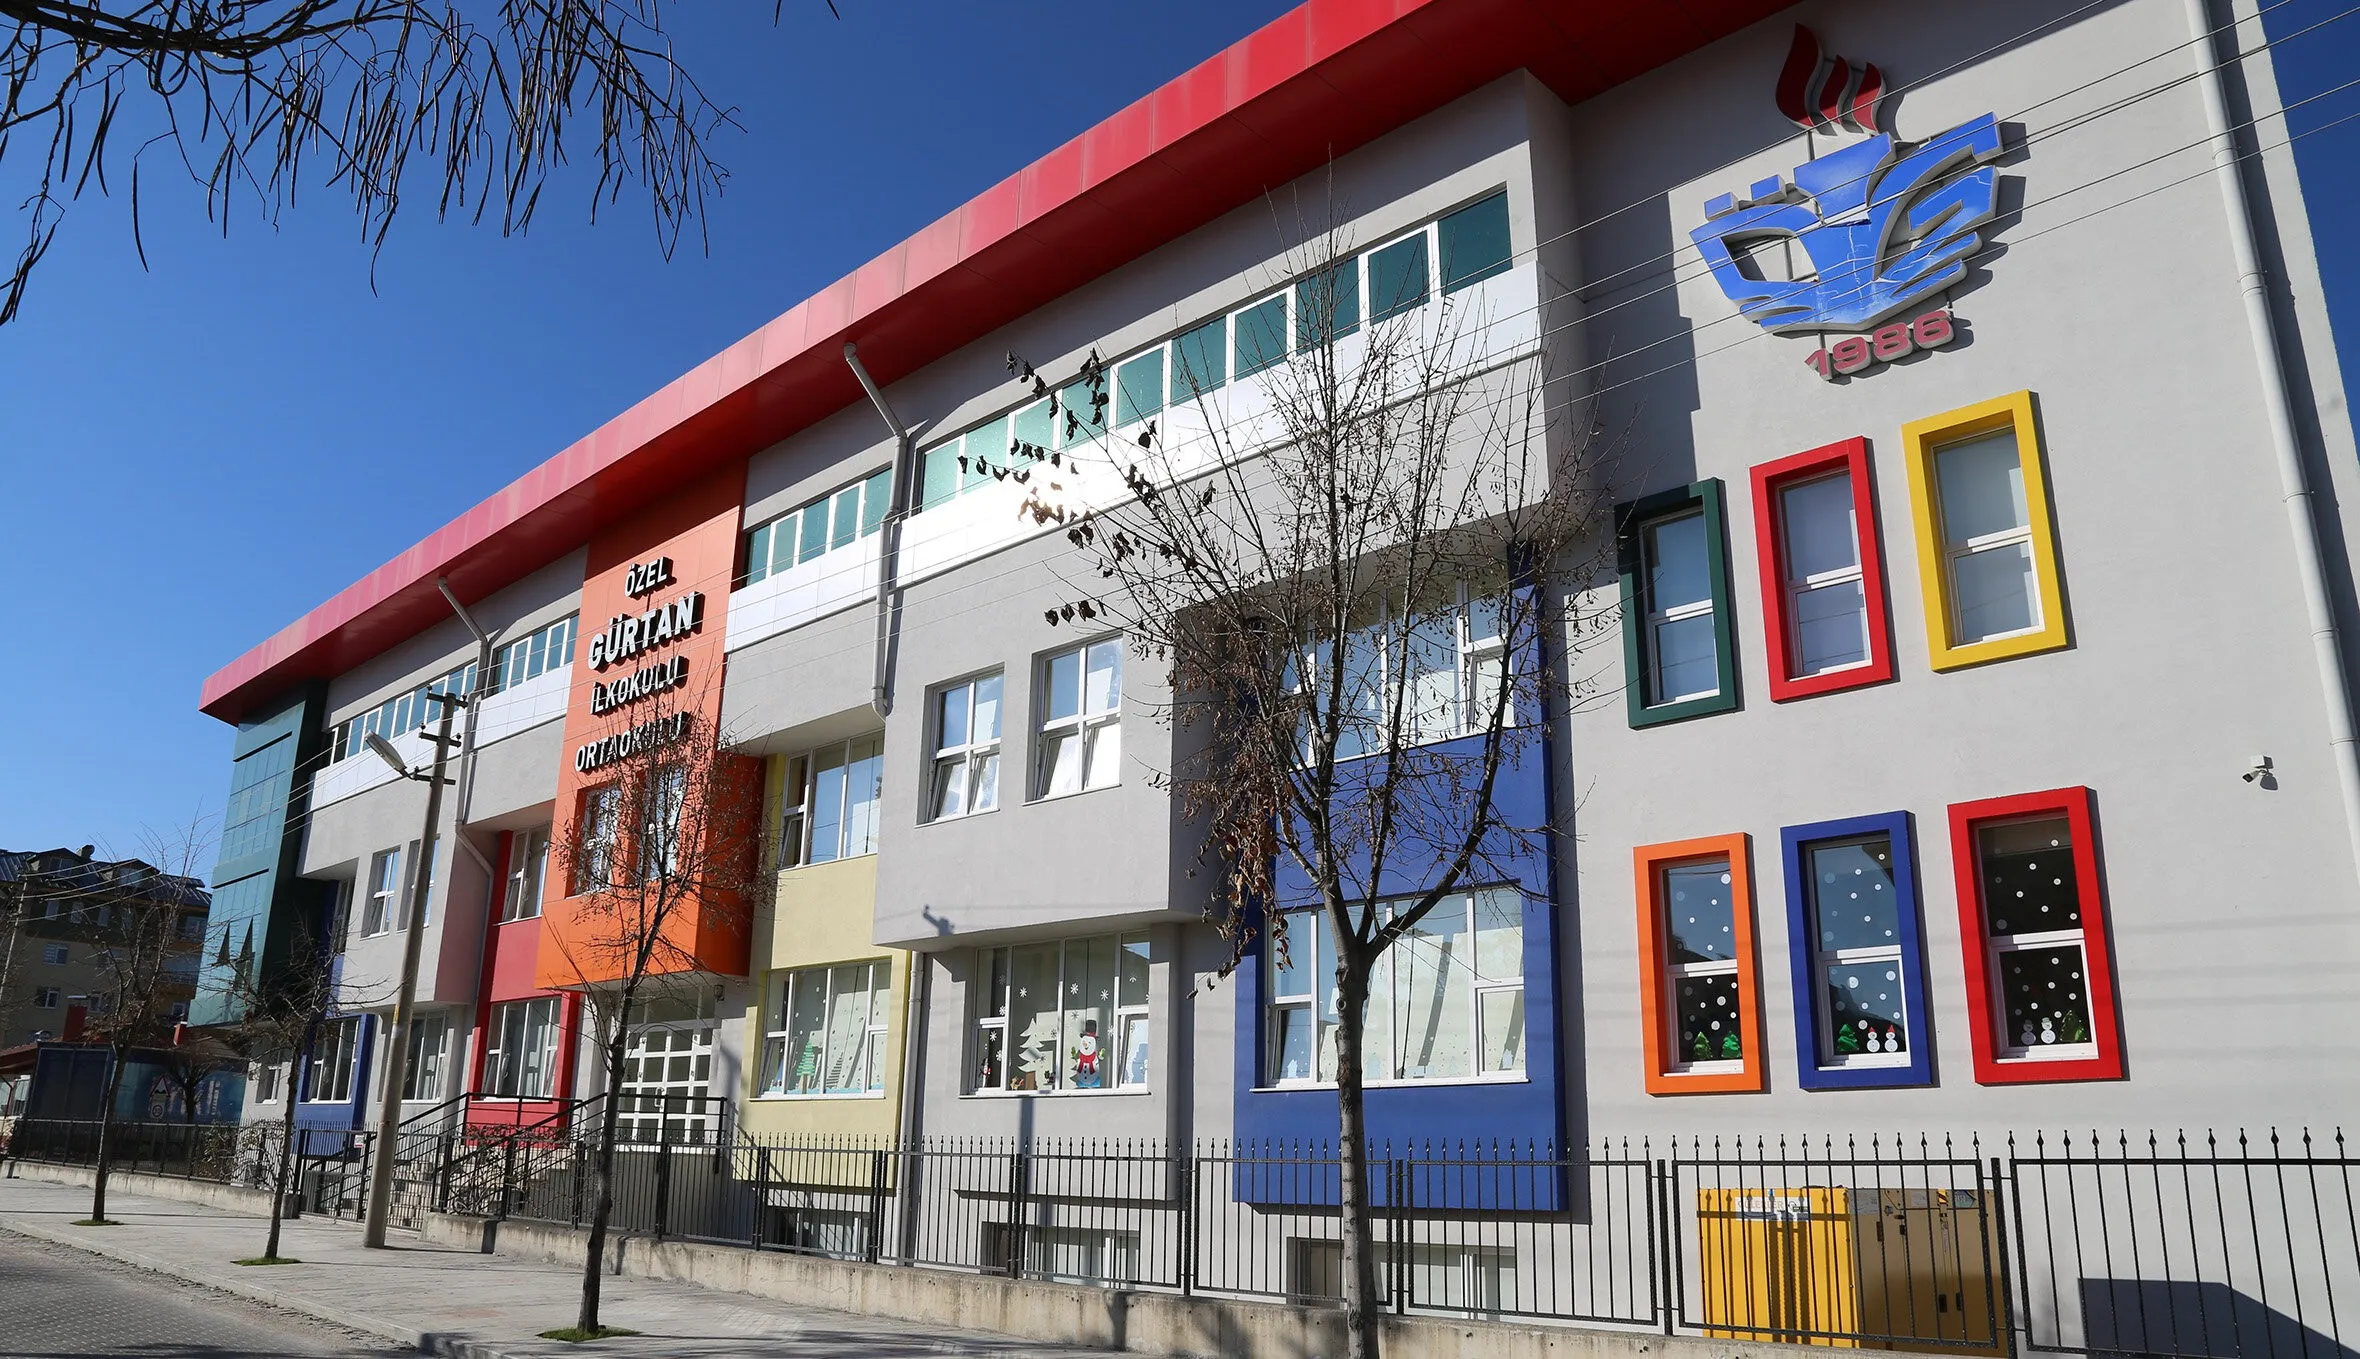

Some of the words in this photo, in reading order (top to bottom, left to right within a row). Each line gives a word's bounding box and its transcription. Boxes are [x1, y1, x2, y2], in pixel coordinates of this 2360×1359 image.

[1804, 310, 1954, 379] 1986
[624, 557, 669, 597] ÖZEL
[589, 592, 697, 670] GÜRTAN
[590, 655, 681, 715] İLKOKULU
